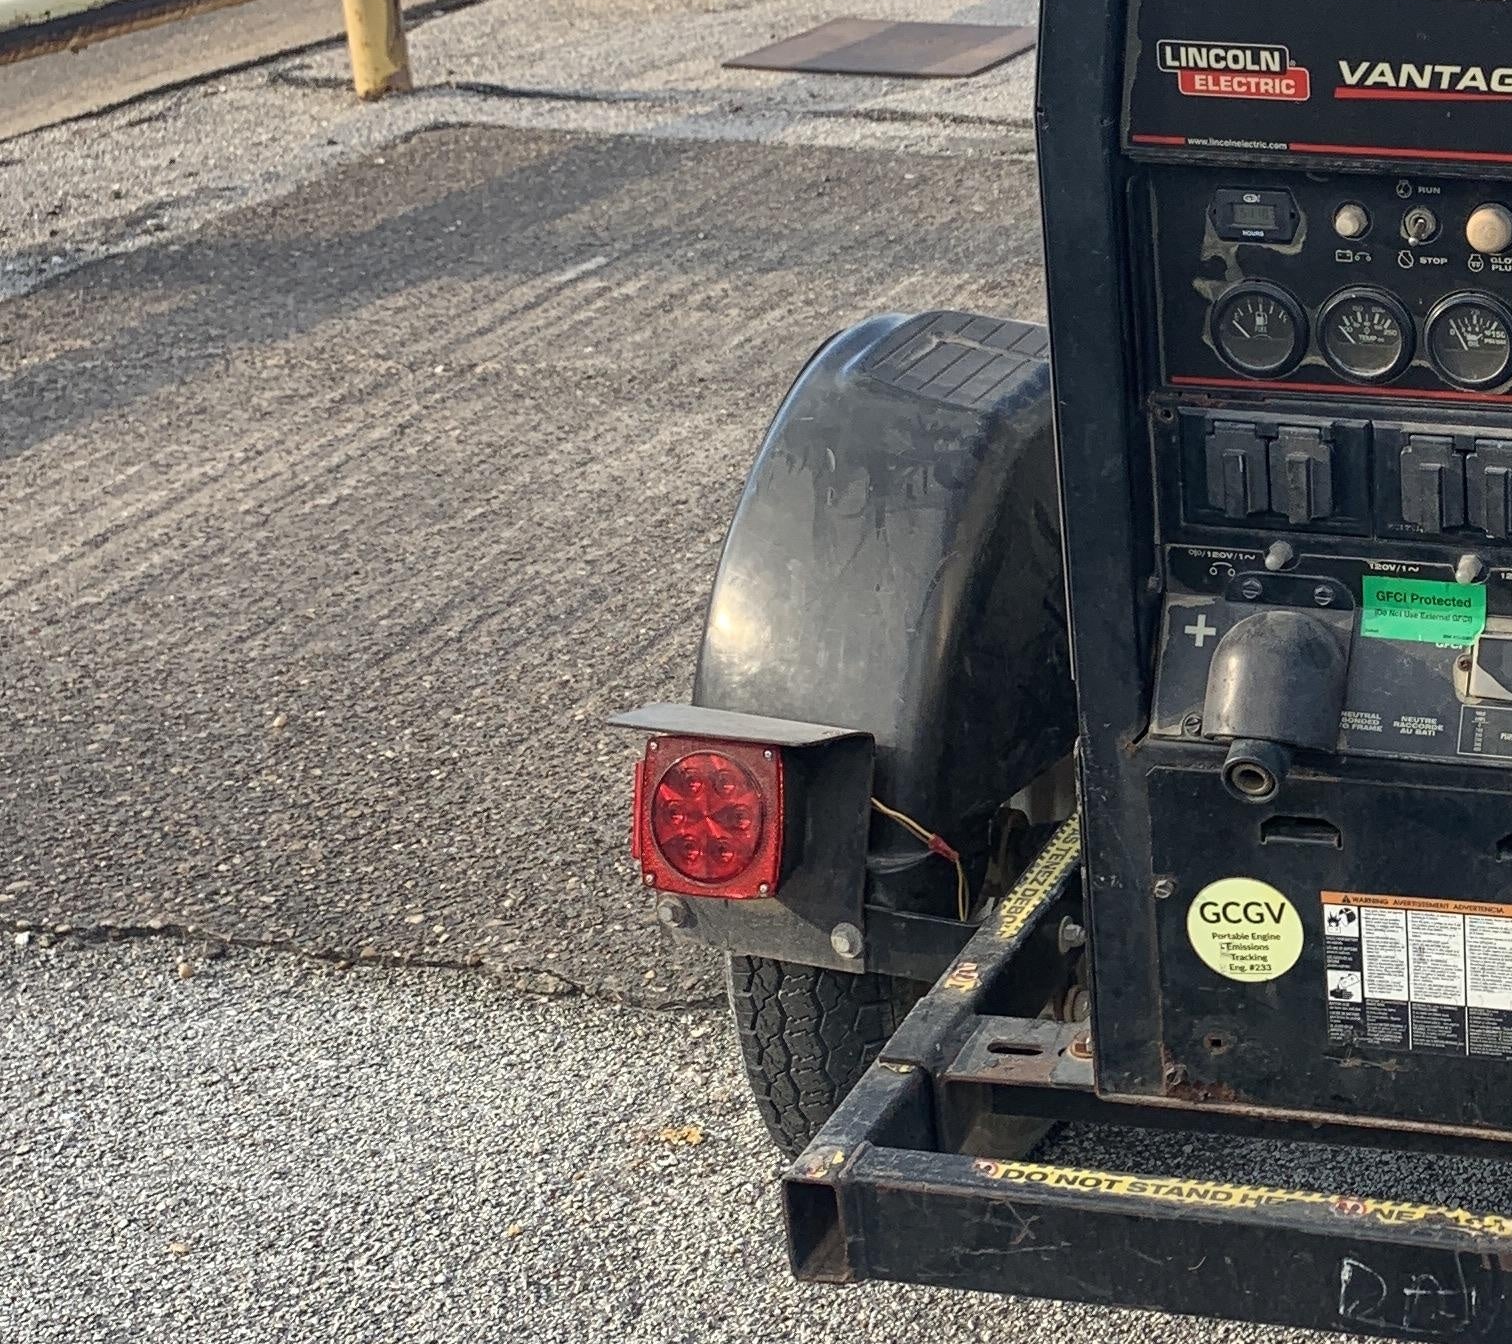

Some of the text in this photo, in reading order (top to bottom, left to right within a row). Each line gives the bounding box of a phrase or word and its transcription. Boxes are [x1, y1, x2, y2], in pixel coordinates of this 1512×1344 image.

[1165, 45, 1281, 72] LINCOLN
[1194, 74, 1296, 95] ELECTRIC
[1187, 136, 1288, 150] www.lincolnelectric.com
[1418, 186, 1441, 194] RUN
[1420, 257, 1448, 265] STOP
[1376, 591, 1472, 607] GFCI Protected
[1389, 609, 1401, 617] Not
[1404, 611, 1418, 619] Use
[1420, 612, 1450, 621] External
[1341, 711, 1382, 720] NEUTRAL
[1401, 716, 1437, 725] NEUTRE
[1341, 717, 1380, 726] BONDED
[1352, 723, 1383, 732] FRAME
[1352, 896, 1389, 905] WARNING
[1453, 904, 1505, 914] ADVERTENCIA
[1200, 901, 1286, 924] GCGV
[1212, 932, 1281, 942] Portable Engine
[1226, 942, 1269, 951] Emissions
[1231, 953, 1268, 963] Tracking
[1229, 963, 1272, 973] Eng. #233
[1002, 1168, 1049, 1184] DO
[1055, 1172, 1120, 1191] NOT
[1127, 1181, 1234, 1203] STAND
